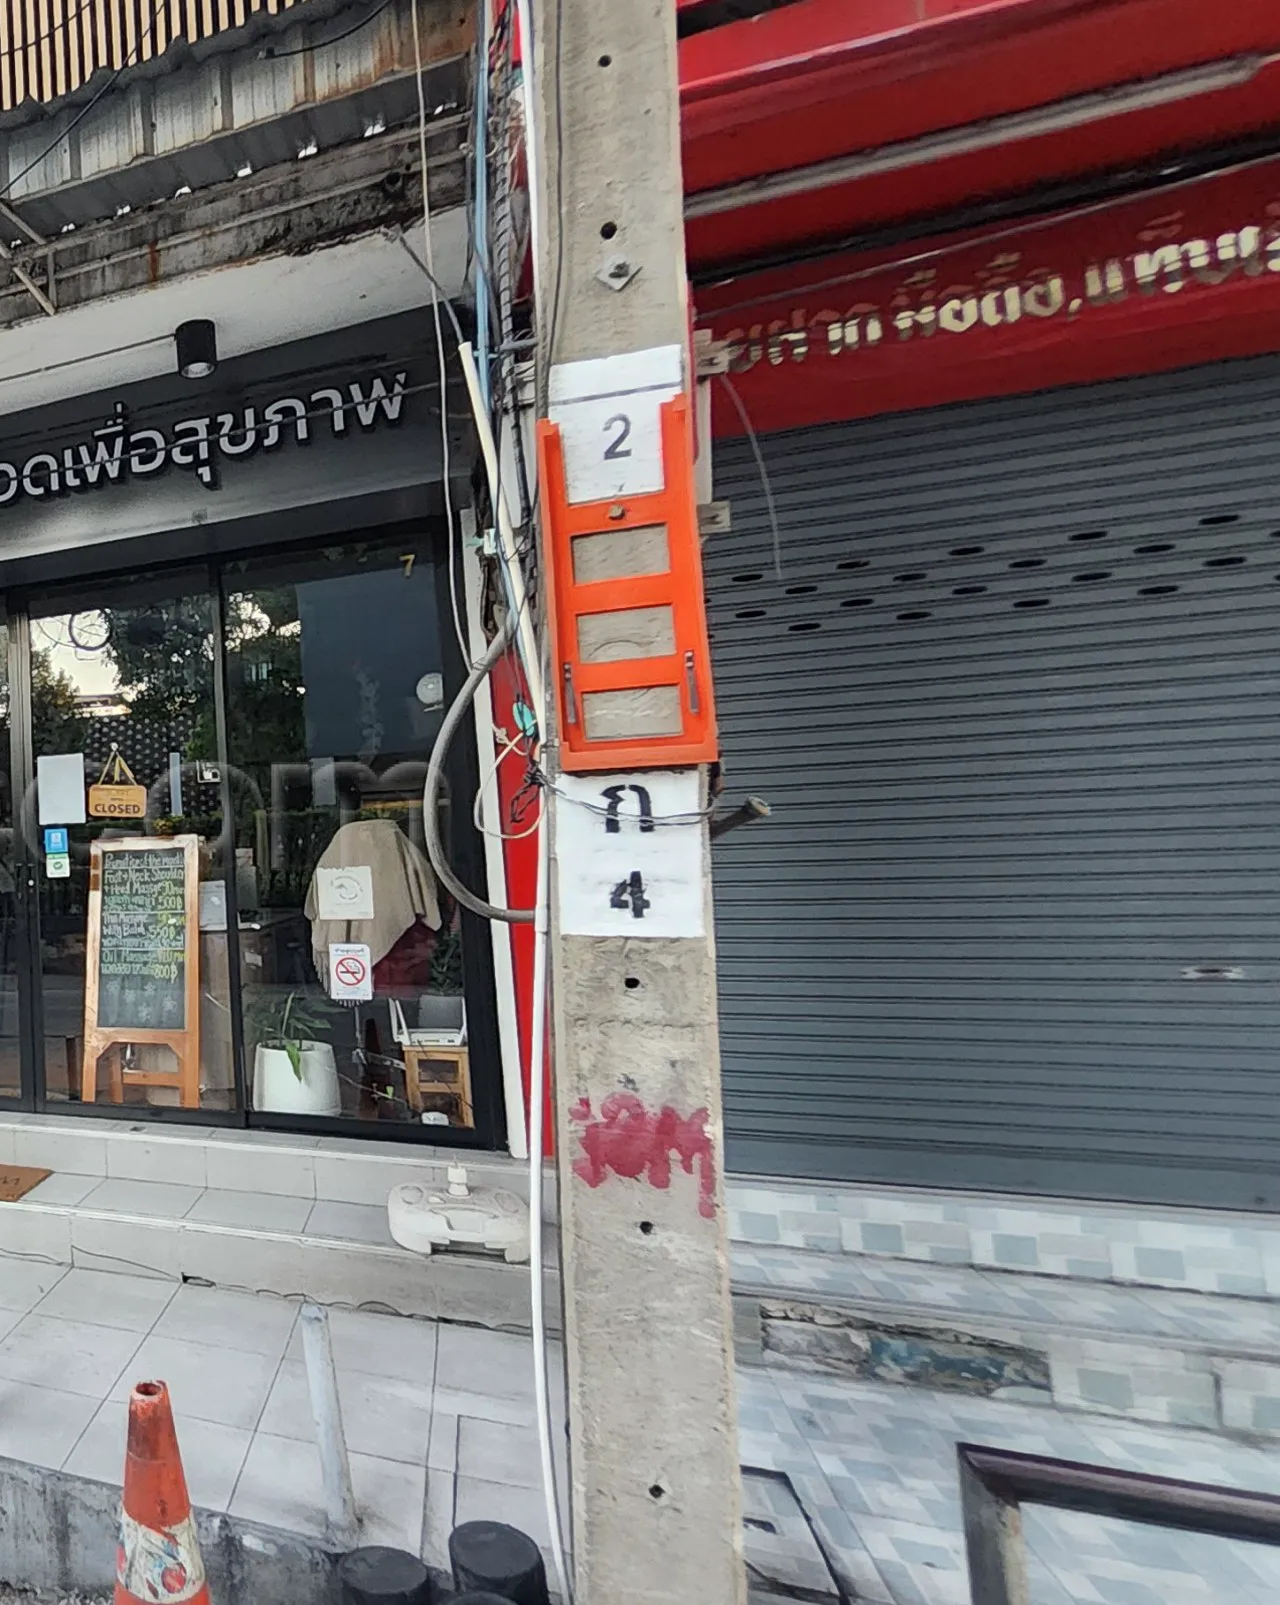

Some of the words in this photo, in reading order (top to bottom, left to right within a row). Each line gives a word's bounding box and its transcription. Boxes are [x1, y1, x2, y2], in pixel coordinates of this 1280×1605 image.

[601, 412, 633, 462] 2
[399, 553, 416, 577] 7
[94, 803, 141, 815] CLOSED
[600, 783, 654, 835] ก
[609, 869, 652, 919] 4
